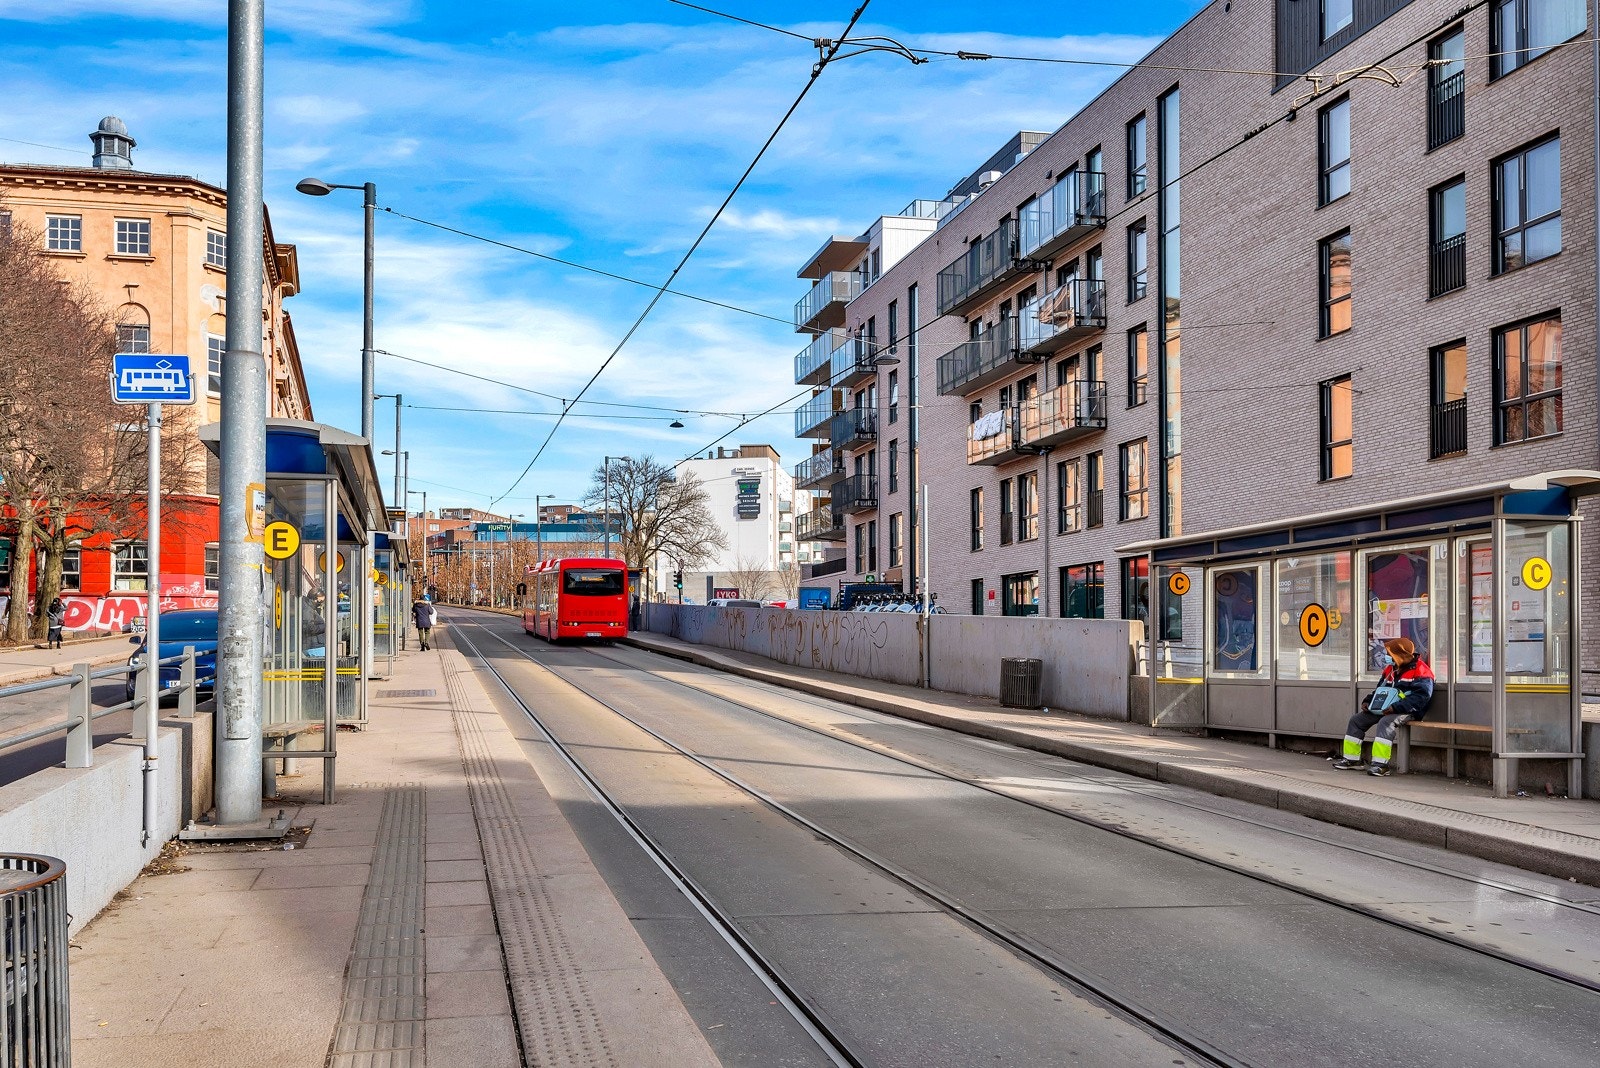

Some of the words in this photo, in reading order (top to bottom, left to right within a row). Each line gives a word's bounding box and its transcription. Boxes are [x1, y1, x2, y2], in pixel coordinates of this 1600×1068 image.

[272, 529, 288, 551] E
[1531, 564, 1544, 583] C
[1174, 577, 1185, 591] C
[716, 590, 737, 599] LYKO
[1307, 612, 1320, 637] C
